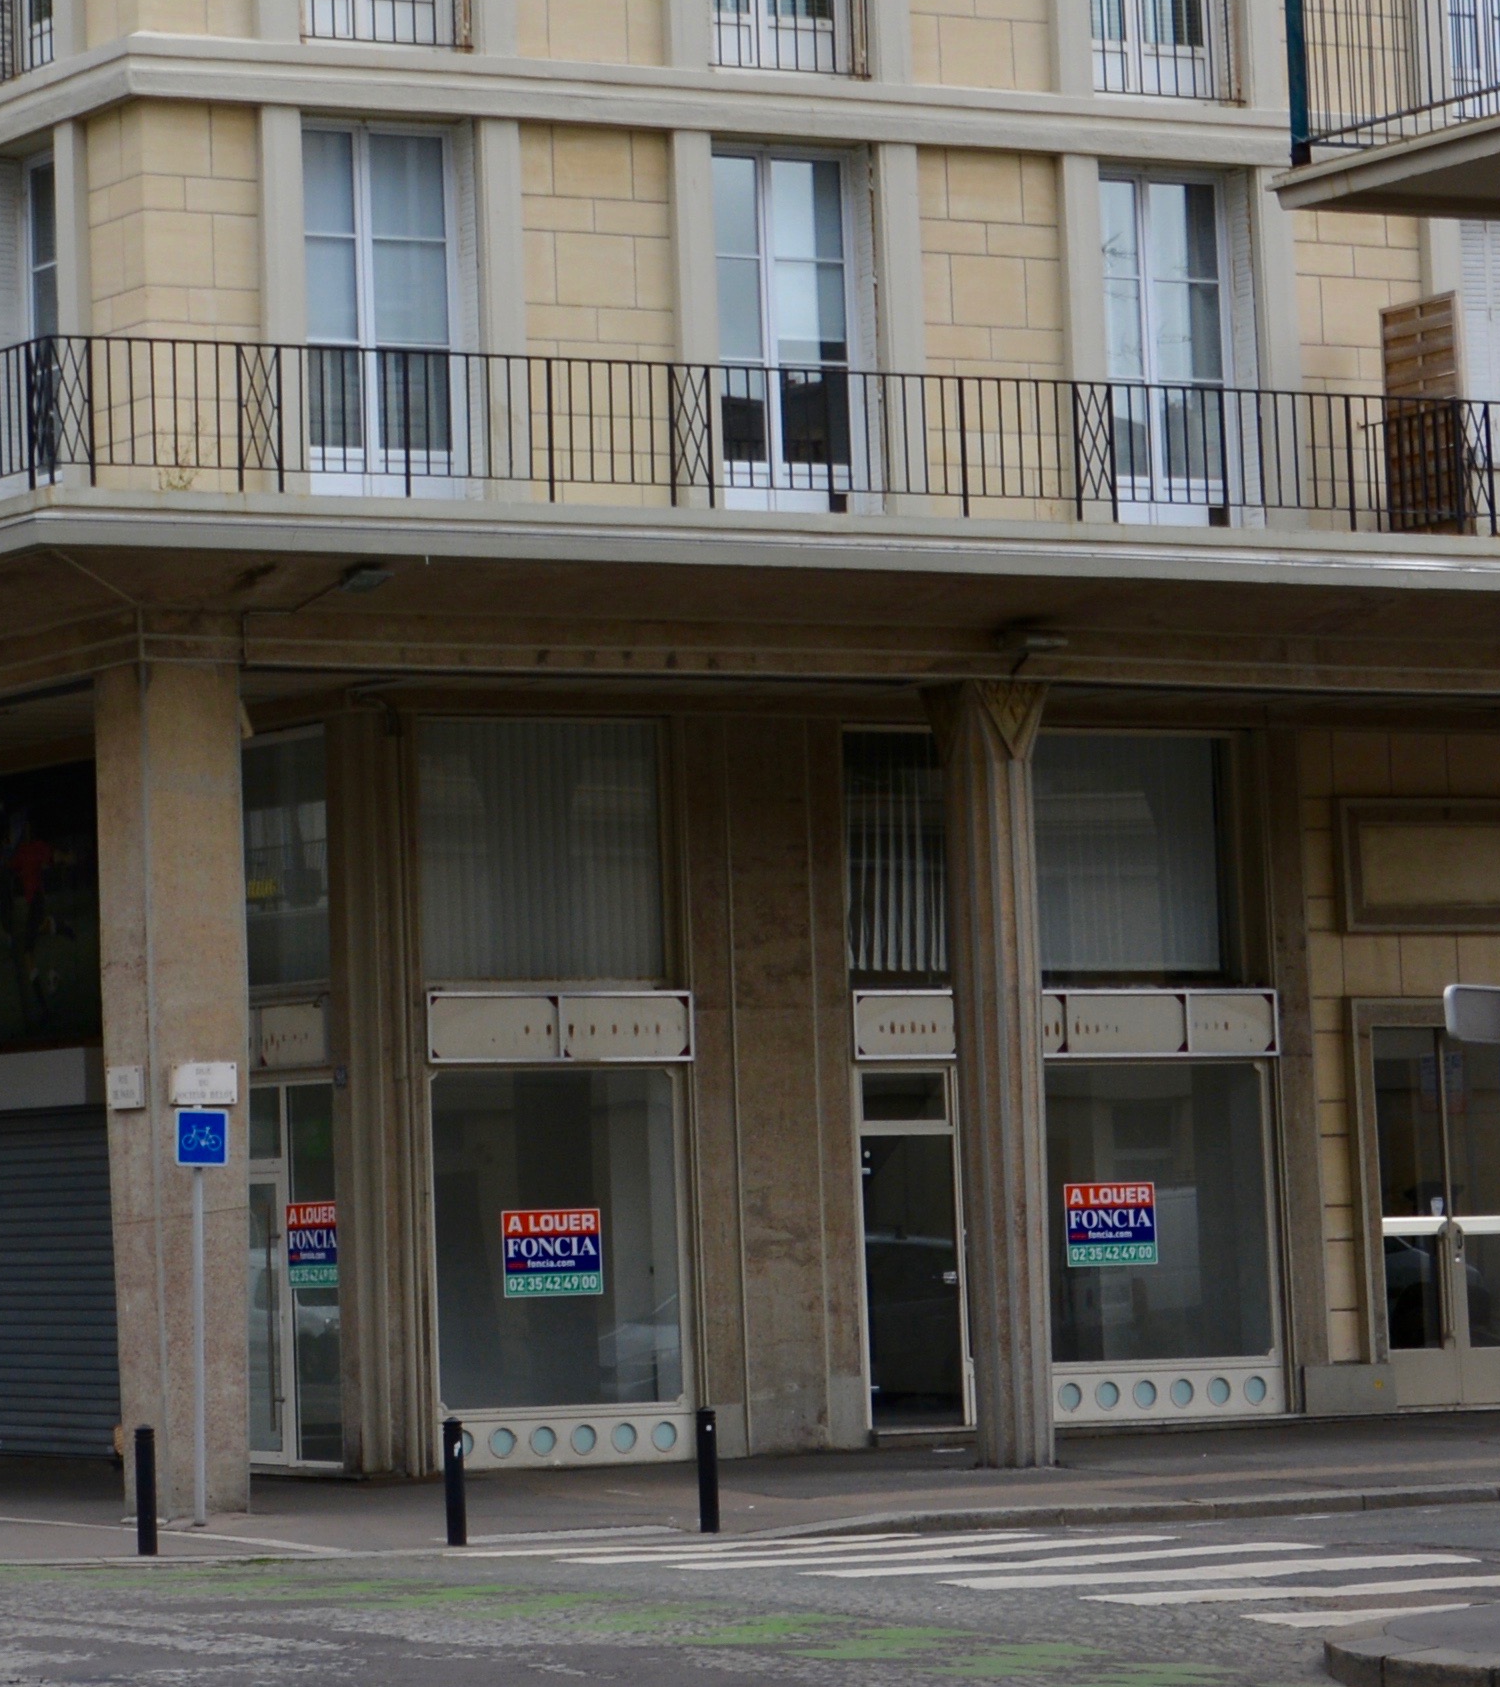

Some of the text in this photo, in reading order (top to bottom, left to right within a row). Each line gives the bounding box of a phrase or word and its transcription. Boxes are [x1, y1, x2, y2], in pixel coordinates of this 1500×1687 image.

[1069, 1186, 1151, 1205] A LOUER
[289, 1205, 336, 1225] A LOUER
[508, 1213, 596, 1233] A LOUER
[1069, 1208, 1152, 1229] FONCIA
[289, 1229, 337, 1250] FONCIA
[1087, 1230, 1133, 1239] foncia.com
[507, 1236, 598, 1258] FONCIA
[1072, 1246, 1152, 1261] 02 35 42 49 00
[526, 1259, 576, 1269] foncia.com
[509, 1275, 597, 1291] 02 35 42 49 00
